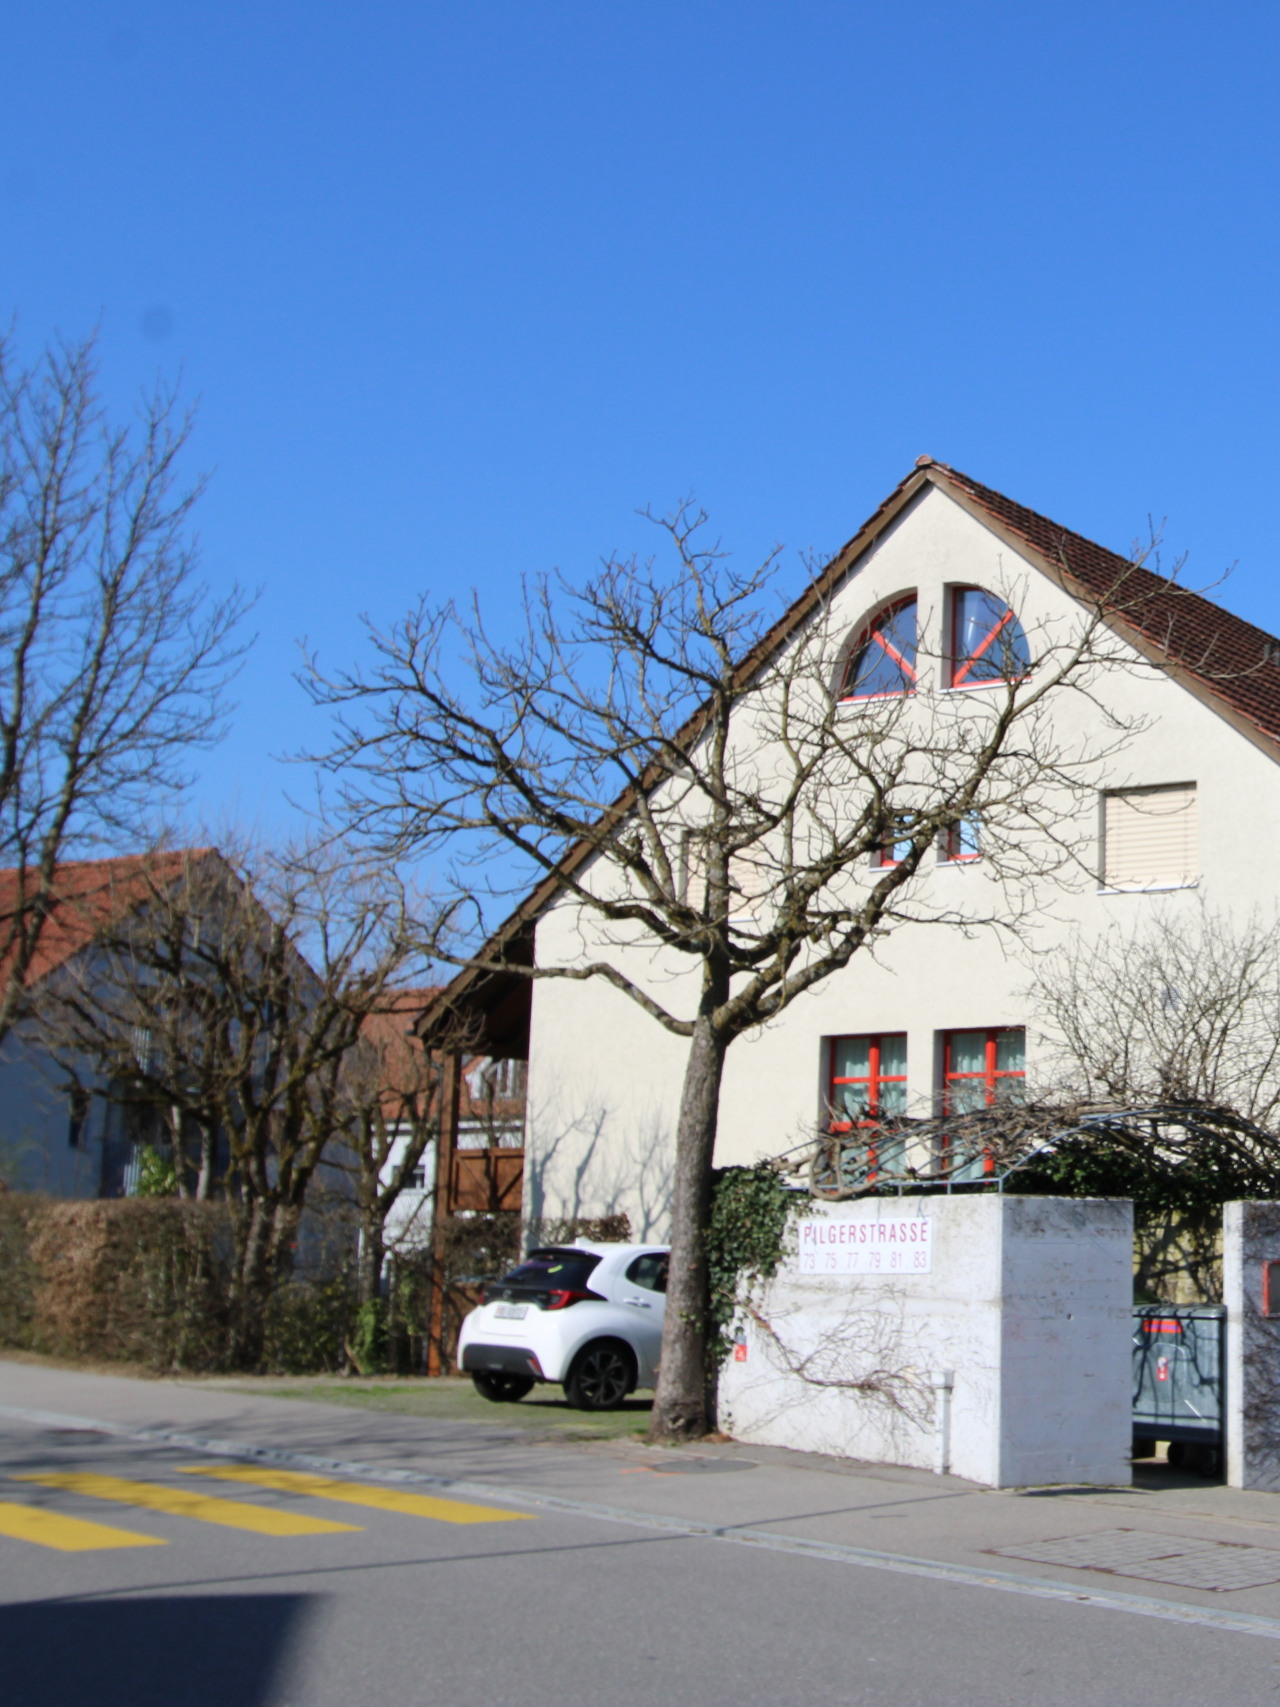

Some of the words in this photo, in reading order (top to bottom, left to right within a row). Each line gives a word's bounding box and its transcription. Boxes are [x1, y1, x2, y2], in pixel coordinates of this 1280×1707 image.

[804, 1222, 928, 1245] PILGERSTRASSE
[803, 1252, 815, 1269] 73
[825, 1252, 837, 1269] 75
[847, 1252, 859, 1269] 77
[869, 1251, 881, 1268] 79
[890, 1251, 902, 1268] 81
[913, 1250, 927, 1268] 83
